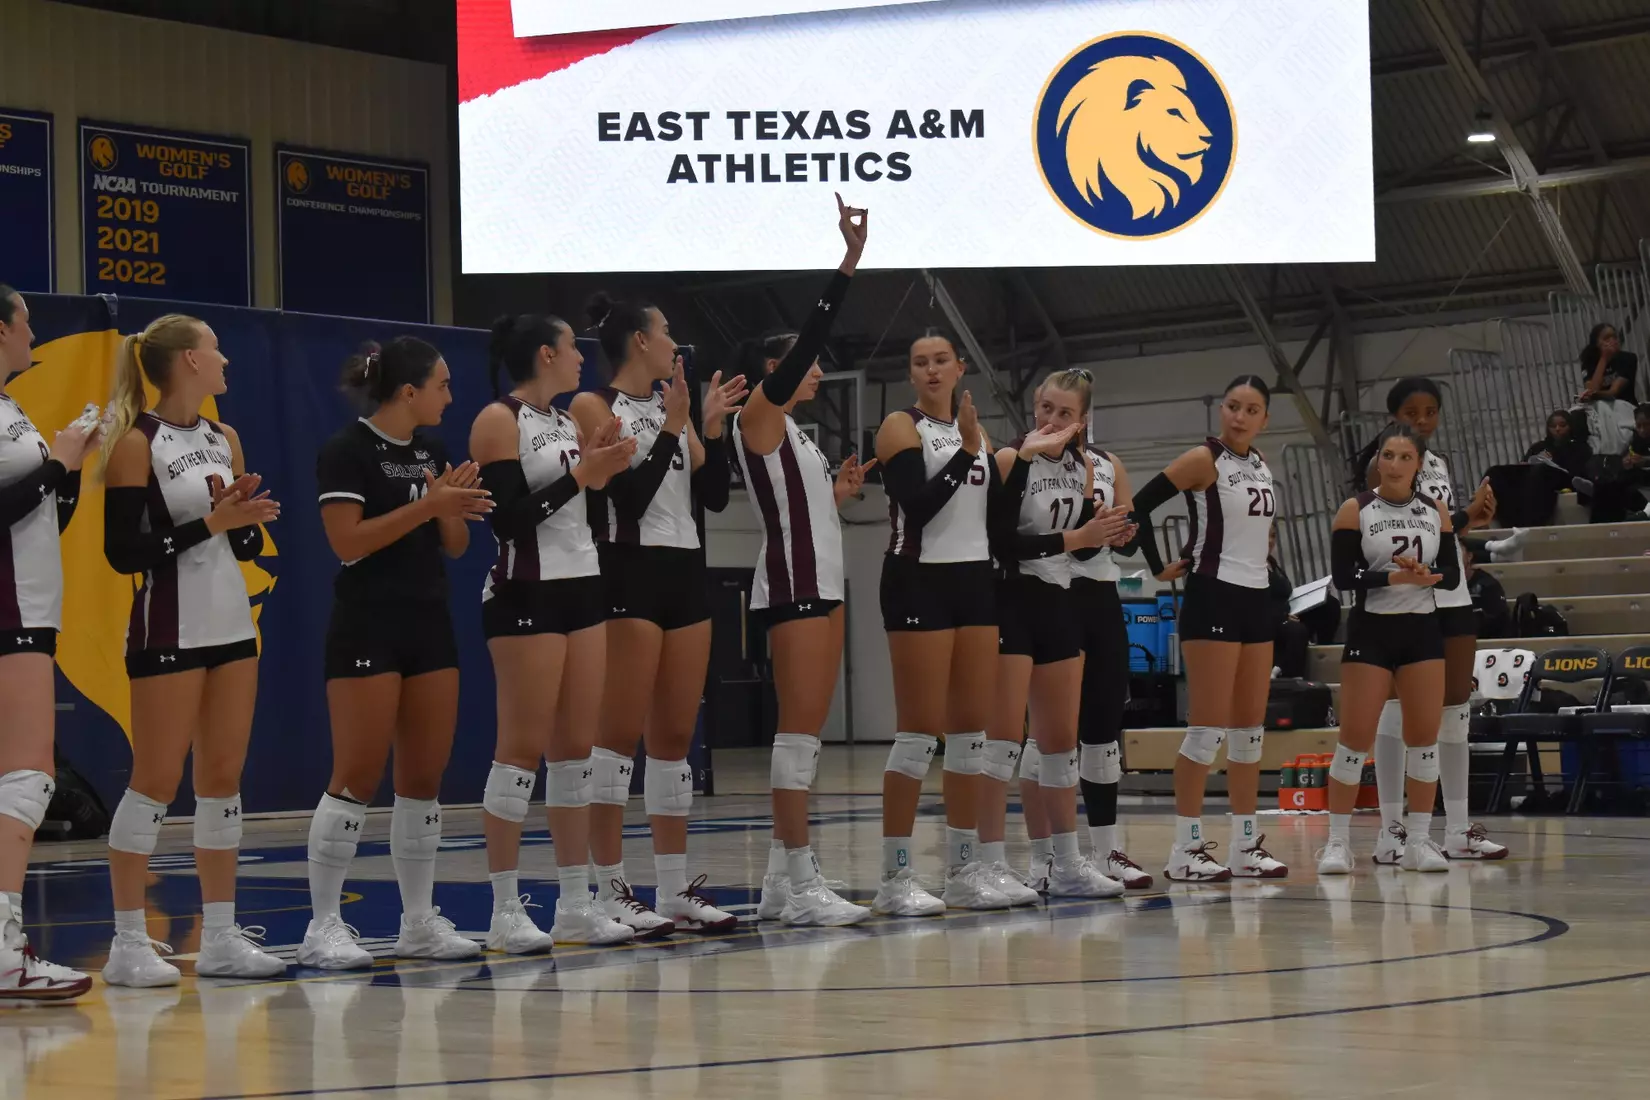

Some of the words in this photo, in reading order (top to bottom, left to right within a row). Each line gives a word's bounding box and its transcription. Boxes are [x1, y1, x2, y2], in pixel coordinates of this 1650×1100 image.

[598, 111, 709, 141] EAST
[727, 110, 871, 140] TEXAS
[886, 109, 984, 139] A&M
[136, 143, 232, 169] WOMEN'S
[667, 152, 912, 183] ATHLETICS
[159, 161, 209, 181] GOLF
[326, 164, 412, 190] WOMEN'S
[93, 174, 136, 194] NCAA
[140, 182, 239, 203] TOURNAMENT
[346, 183, 391, 200] GOLF
[97, 195, 160, 224] 2019
[286, 197, 346, 213] CONFERENCE
[348, 205, 422, 222] CHAMPIONSHIPS
[97, 226, 159, 254] 2021
[98, 257, 166, 285] 2022
[1050, 498, 1074, 530] 17
[1247, 488, 1274, 517] 20
[1369, 519, 1405, 536] SOUTHERN
[1408, 519, 1436, 536] ILLINOIS
[1391, 535, 1423, 563] 21
[1544, 656, 1598, 672] LIONS
[1292, 791, 1305, 807] G
